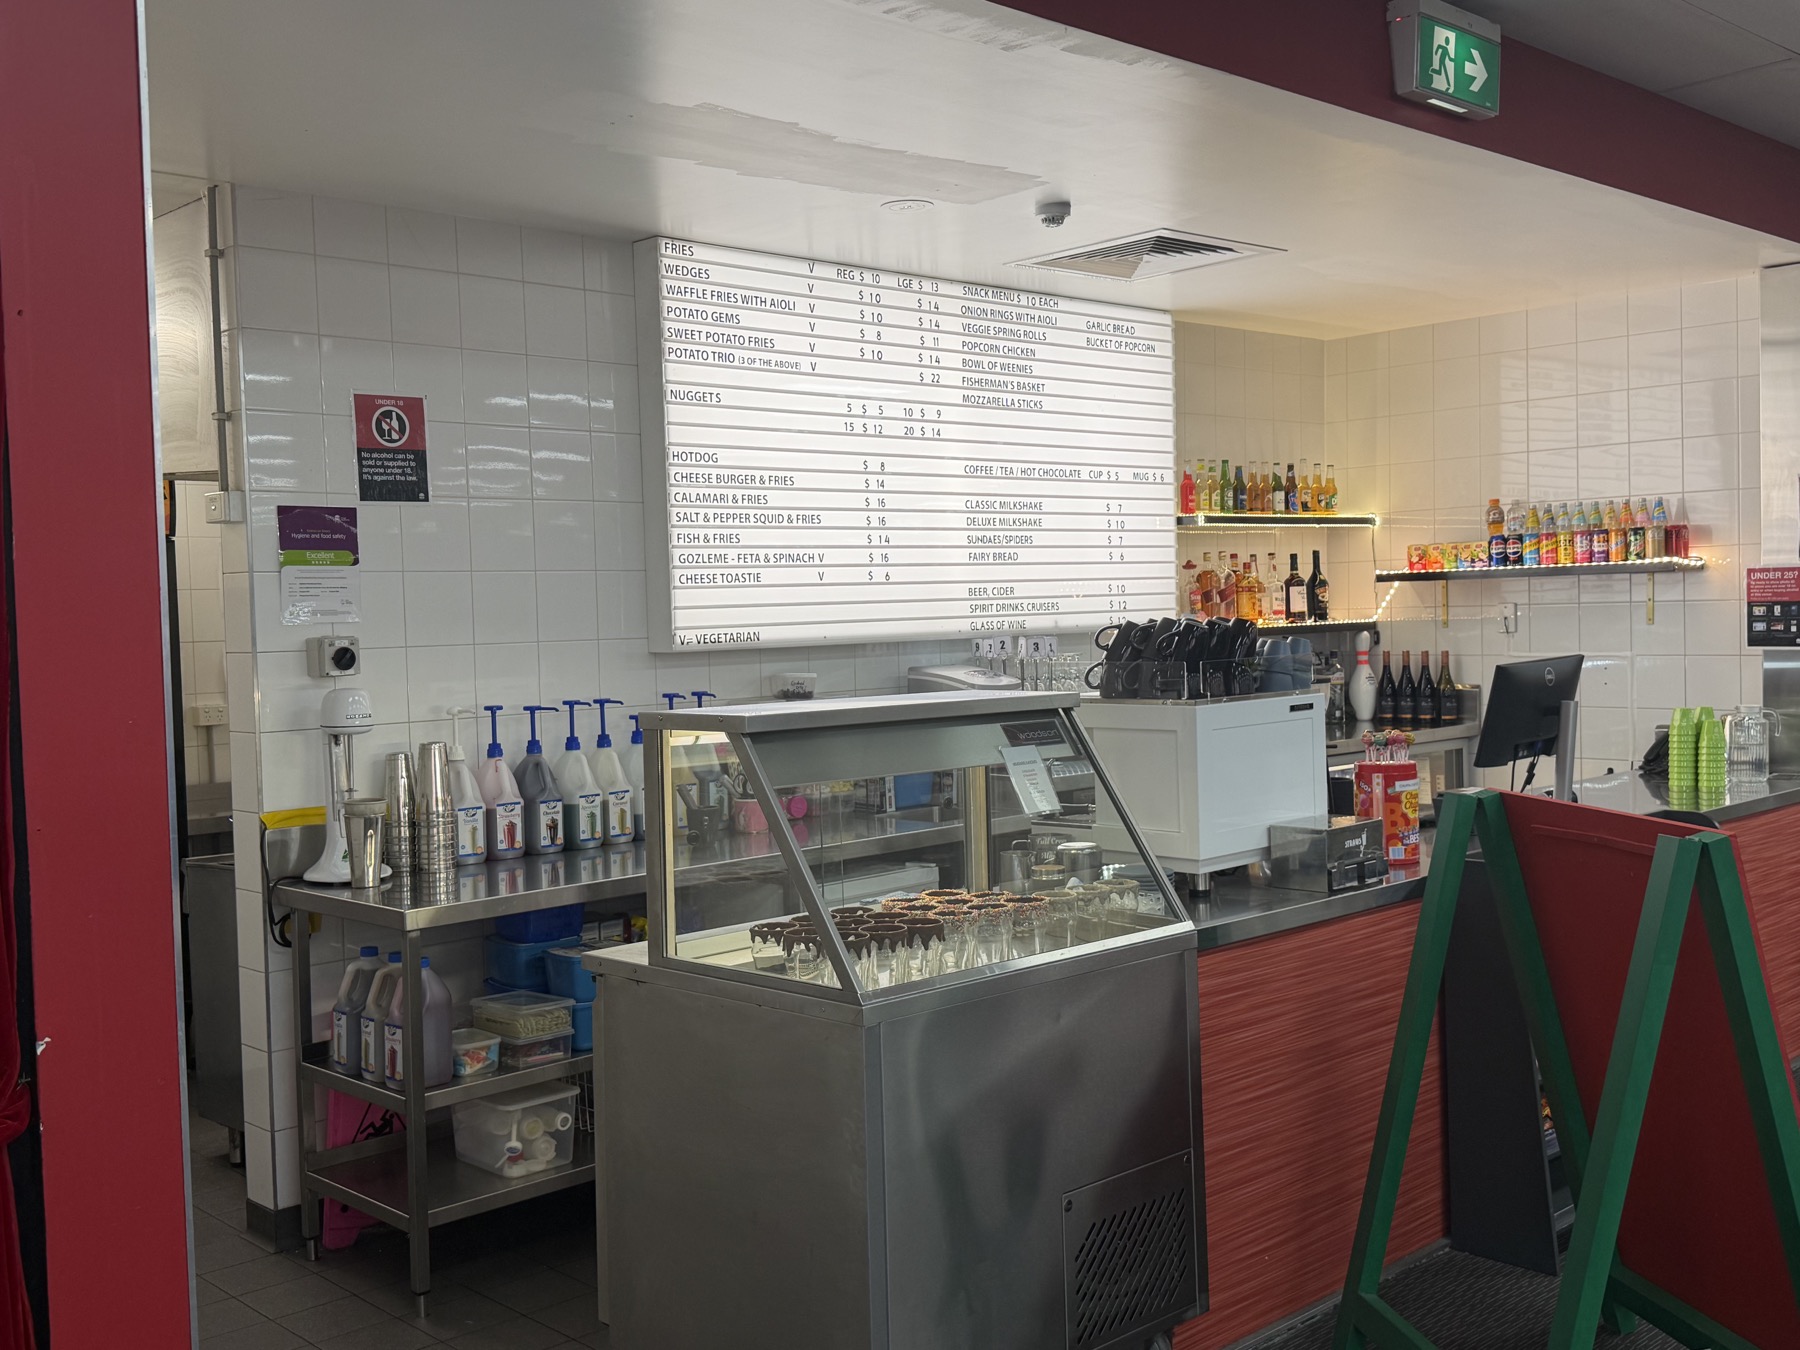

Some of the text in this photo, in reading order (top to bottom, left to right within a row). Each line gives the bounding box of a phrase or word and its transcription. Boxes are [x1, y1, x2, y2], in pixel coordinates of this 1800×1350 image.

[664, 242, 694, 256] FRIES
[664, 264, 710, 279] WEDGES
[808, 263, 814, 273] V
[837, 269, 880, 283] REG $ 10
[808, 283, 814, 293] V
[898, 278, 939, 292] LGE $ 13
[666, 284, 796, 311] WAFFLE FRIES WITH AIOLI
[963, 286, 990, 299] SNACK
[992, 291, 1014, 302] MENU
[1027, 296, 1036, 306] 10
[1039, 298, 1058, 308] EACH
[809, 303, 815, 313] V
[667, 306, 740, 324] POTATO GEMS
[961, 306, 1057, 325] ONION RINGS WITH AIOLI
[809, 322, 815, 332] V
[962, 323, 1046, 341] VEGGIE SPRING ROLLS
[1086, 321, 1135, 335] GARLIC BREAD
[667, 327, 775, 348] SWEET POTATO FRIES
[809, 343, 815, 352] V
[962, 341, 1035, 358] POPCORN CHICKEN
[1087, 338, 1155, 353] BUCKET OF POPCORN
[668, 347, 801, 370] POTATO TRIO (3 OF THE ABOVE)
[811, 362, 816, 371] V
[962, 359, 1033, 374] BOWL OF WEENIES
[920, 372, 940, 383] $ 22
[962, 377, 1045, 392] FISHERMAN'S BASKET
[670, 390, 721, 403] NUGGETS
[962, 394, 1043, 409] MOZZARELLA STICKS
[672, 451, 718, 463] HOTDOG
[373, 474, 395, 482] against
[674, 472, 794, 486] CHEESE BURGER & FRIES
[964, 464, 993, 475] COFFEE
[1000, 467, 1014, 475] TEA
[1021, 468, 1036, 477] HOT
[1038, 468, 1081, 478] CHOCOLATE
[1089, 470, 1103, 479] CUP
[1115, 472, 1119, 480] 5
[1161, 474, 1164, 482] 6
[674, 492, 768, 504] CALAMARI & FRIES
[965, 500, 1043, 510] CLASSIC MILKSHAKE
[676, 512, 821, 524] SALT & PEPPER SQUID & FRIES
[967, 517, 1042, 527] DELUXE MILKSHAKE
[677, 533, 740, 543] FISH & FRIES
[967, 534, 1033, 544] SUNDAES/SPIDERS
[679, 554, 728, 563] GOZLEME
[737, 553, 761, 563] FETA
[764, 553, 771, 563] &
[773, 553, 814, 563] SPINACH
[818, 553, 824, 562] V
[969, 552, 1018, 562] FAIRY BREAD
[679, 572, 761, 584] CHEESE TOASTIE
[818, 572, 824, 581] V
[968, 587, 1014, 598] BEER, CIDER
[970, 604, 994, 614] SPIRIT
[1027, 602, 1059, 611] CRUISERS
[970, 620, 1026, 631] GLASS OF WINE
[695, 632, 760, 644] VEGETARIAN
[1000, 640, 1005, 649] 2
[1033, 642, 1039, 651] 3
[1017, 729, 1059, 739] woodson
